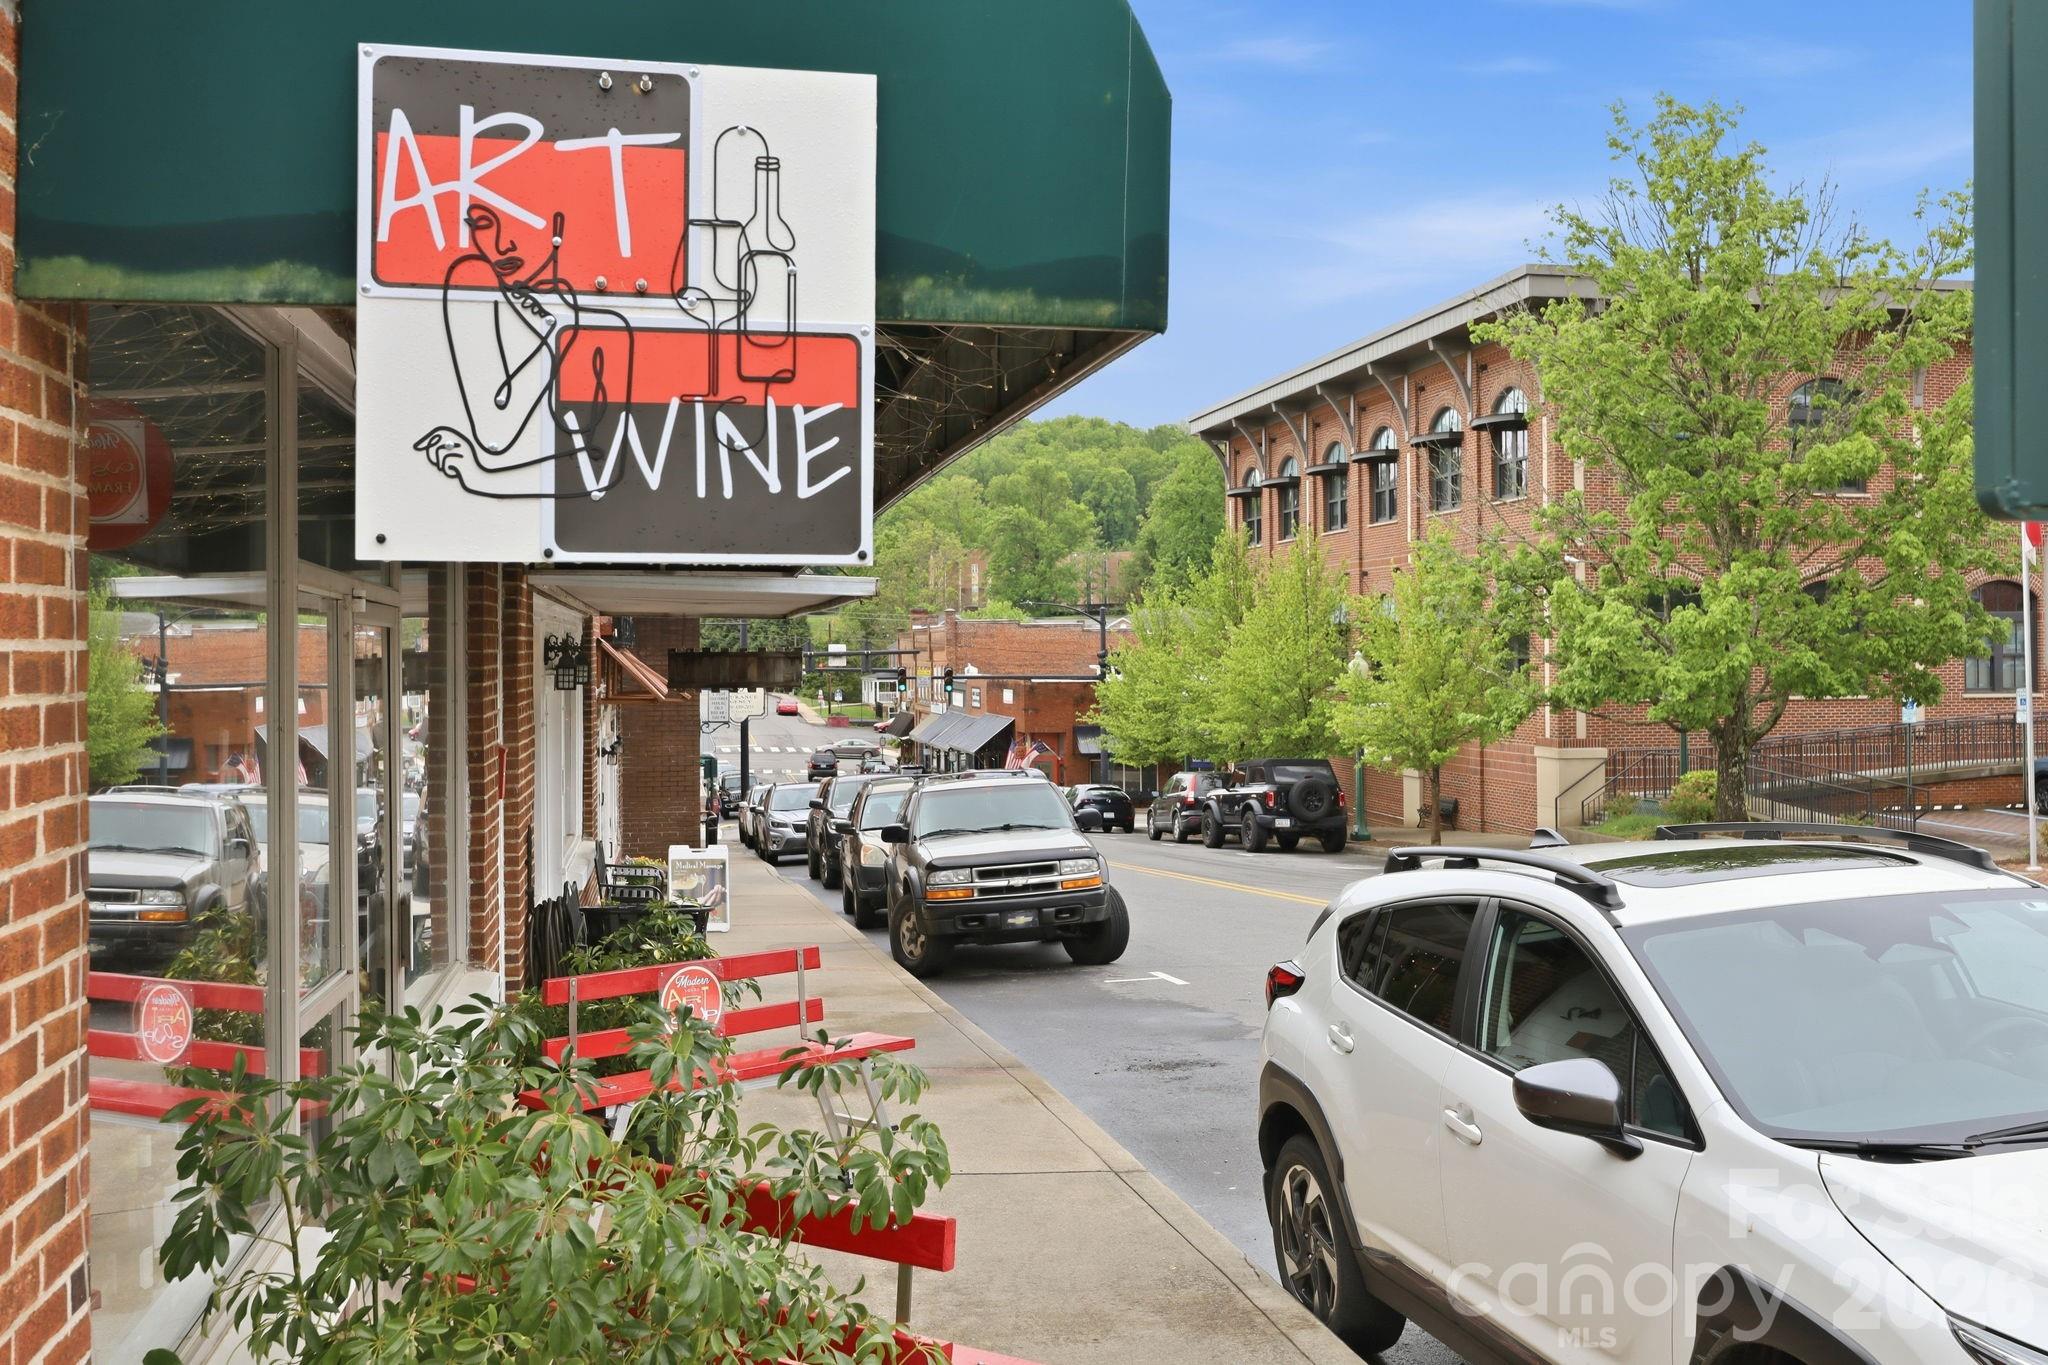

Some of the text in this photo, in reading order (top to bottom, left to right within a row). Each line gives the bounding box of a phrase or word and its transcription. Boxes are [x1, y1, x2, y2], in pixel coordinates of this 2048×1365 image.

[377, 105, 681, 257] ART
[564, 396, 851, 500] WINE
[675, 861, 699, 869] Medical
[675, 975, 711, 988] Modern
